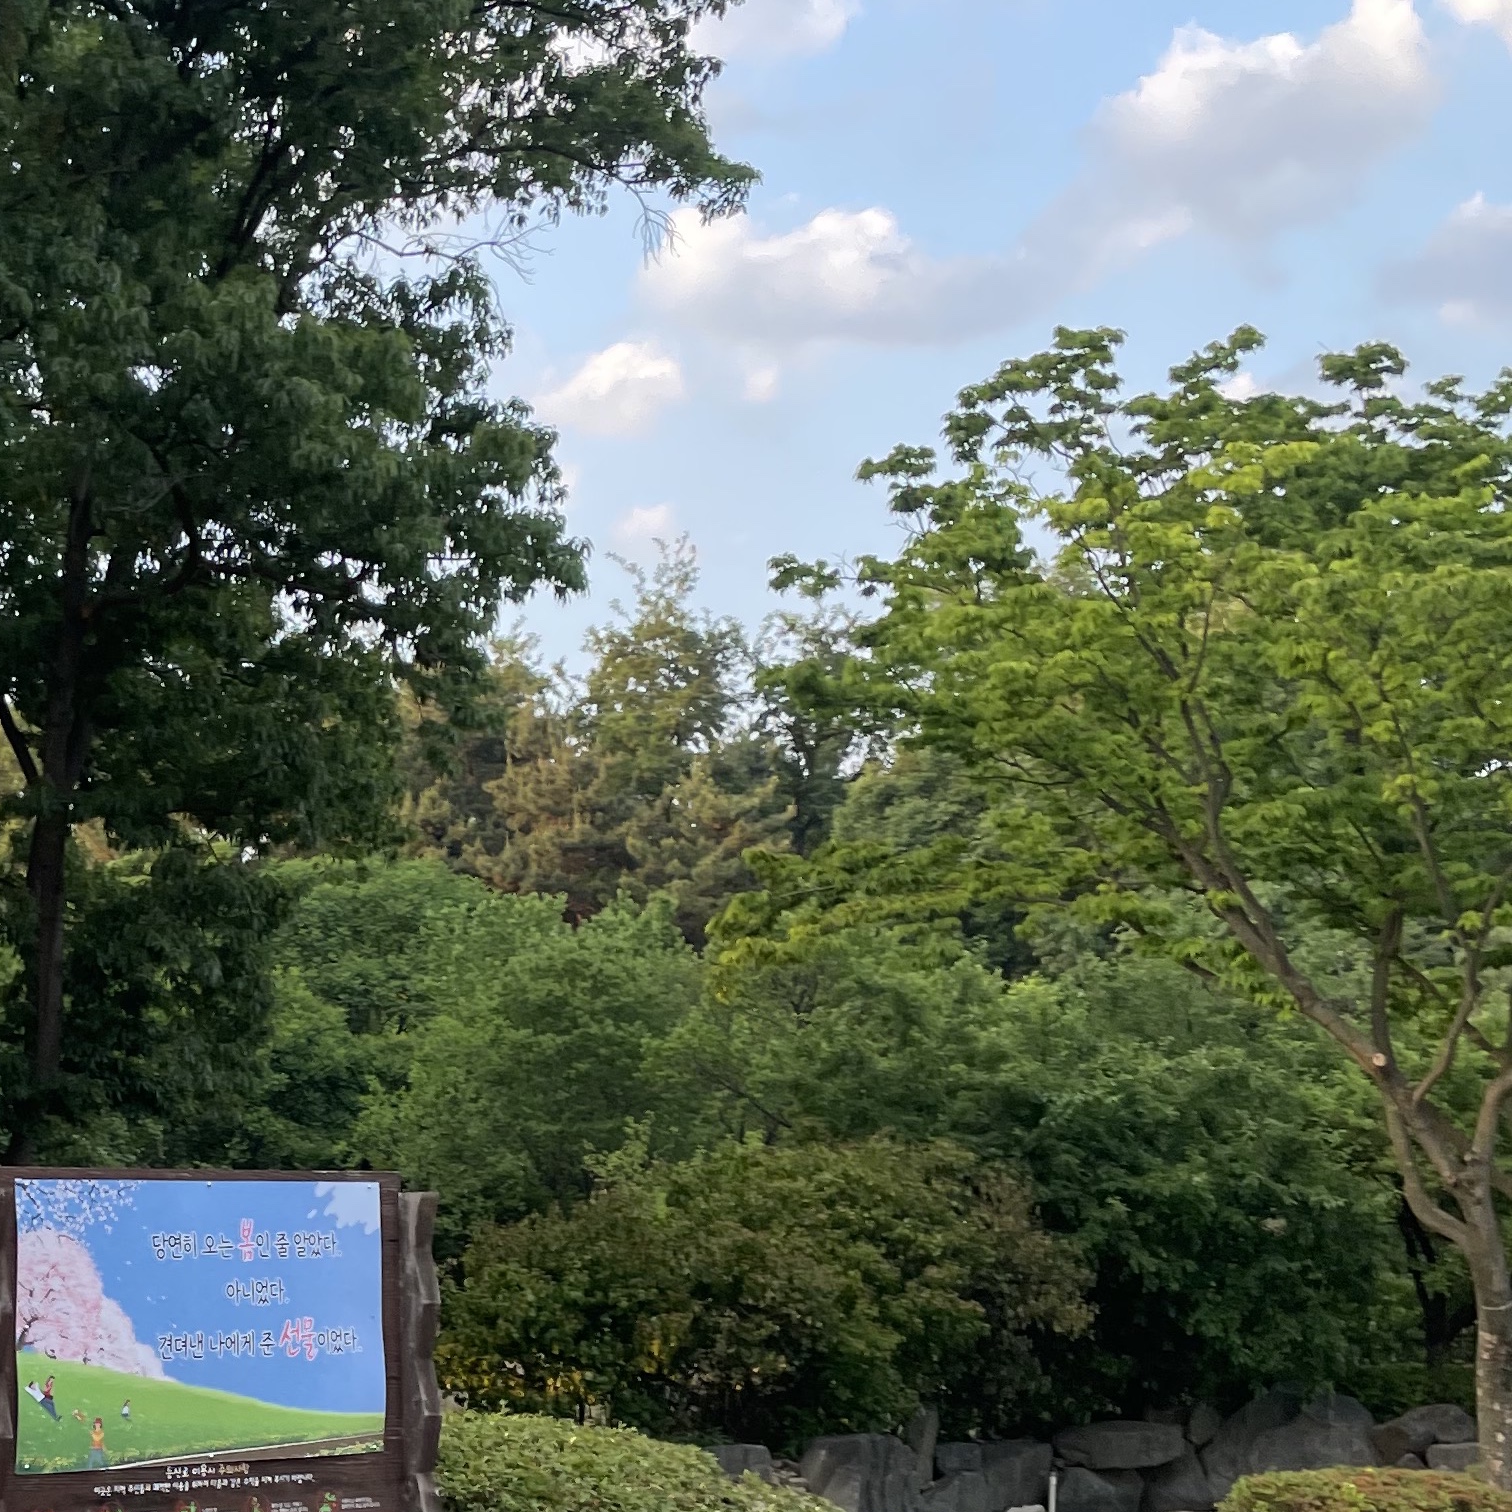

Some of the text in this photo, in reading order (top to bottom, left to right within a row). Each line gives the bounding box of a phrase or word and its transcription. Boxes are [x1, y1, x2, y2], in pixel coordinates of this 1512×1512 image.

[151, 1231, 197, 1261] 당연히
[201, 1232, 234, 1259] 오는
[237, 1217, 271, 1262] 봄인
[274, 1231, 290, 1259] 줄
[158, 1329, 205, 1361] 견뎌낸
[209, 1329, 256, 1356] 나에게
[259, 1329, 276, 1356] 준
